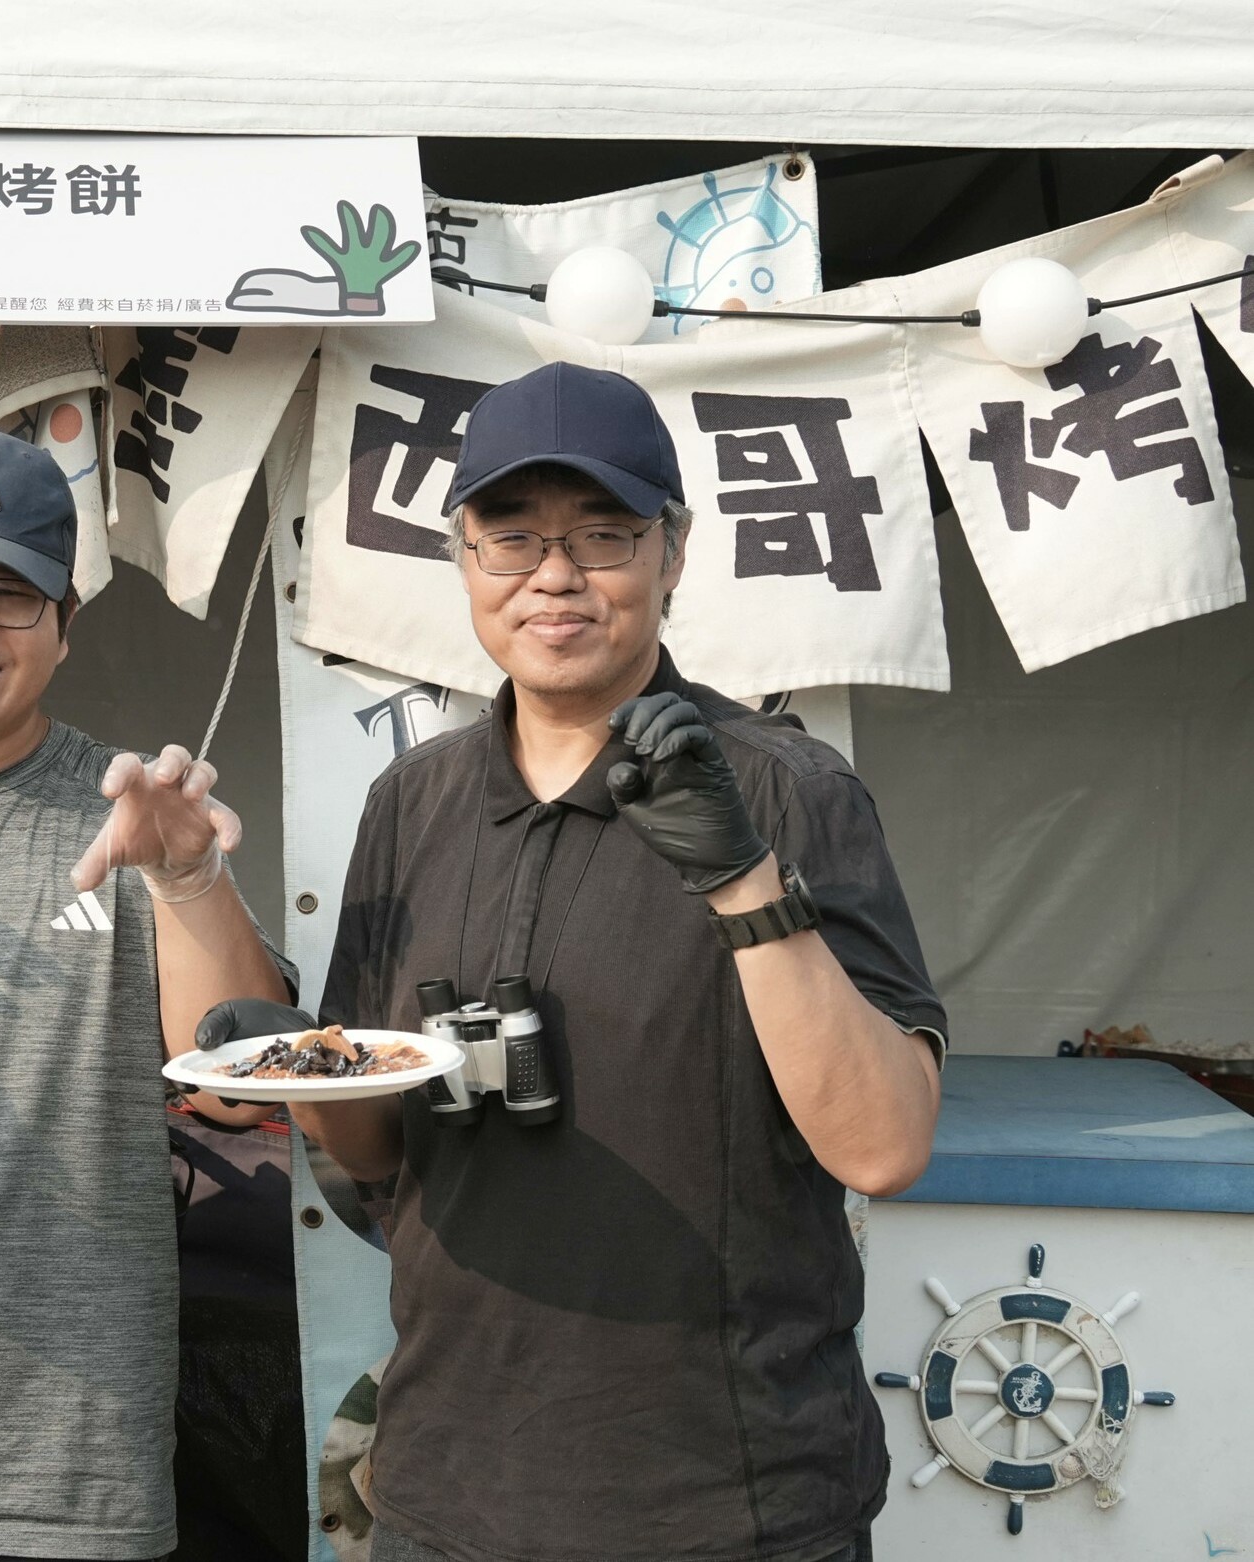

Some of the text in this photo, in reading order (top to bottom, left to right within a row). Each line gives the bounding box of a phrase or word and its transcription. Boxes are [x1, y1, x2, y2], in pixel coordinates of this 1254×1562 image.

[58, 297, 223, 312] 經費來自菸捐/廣告
